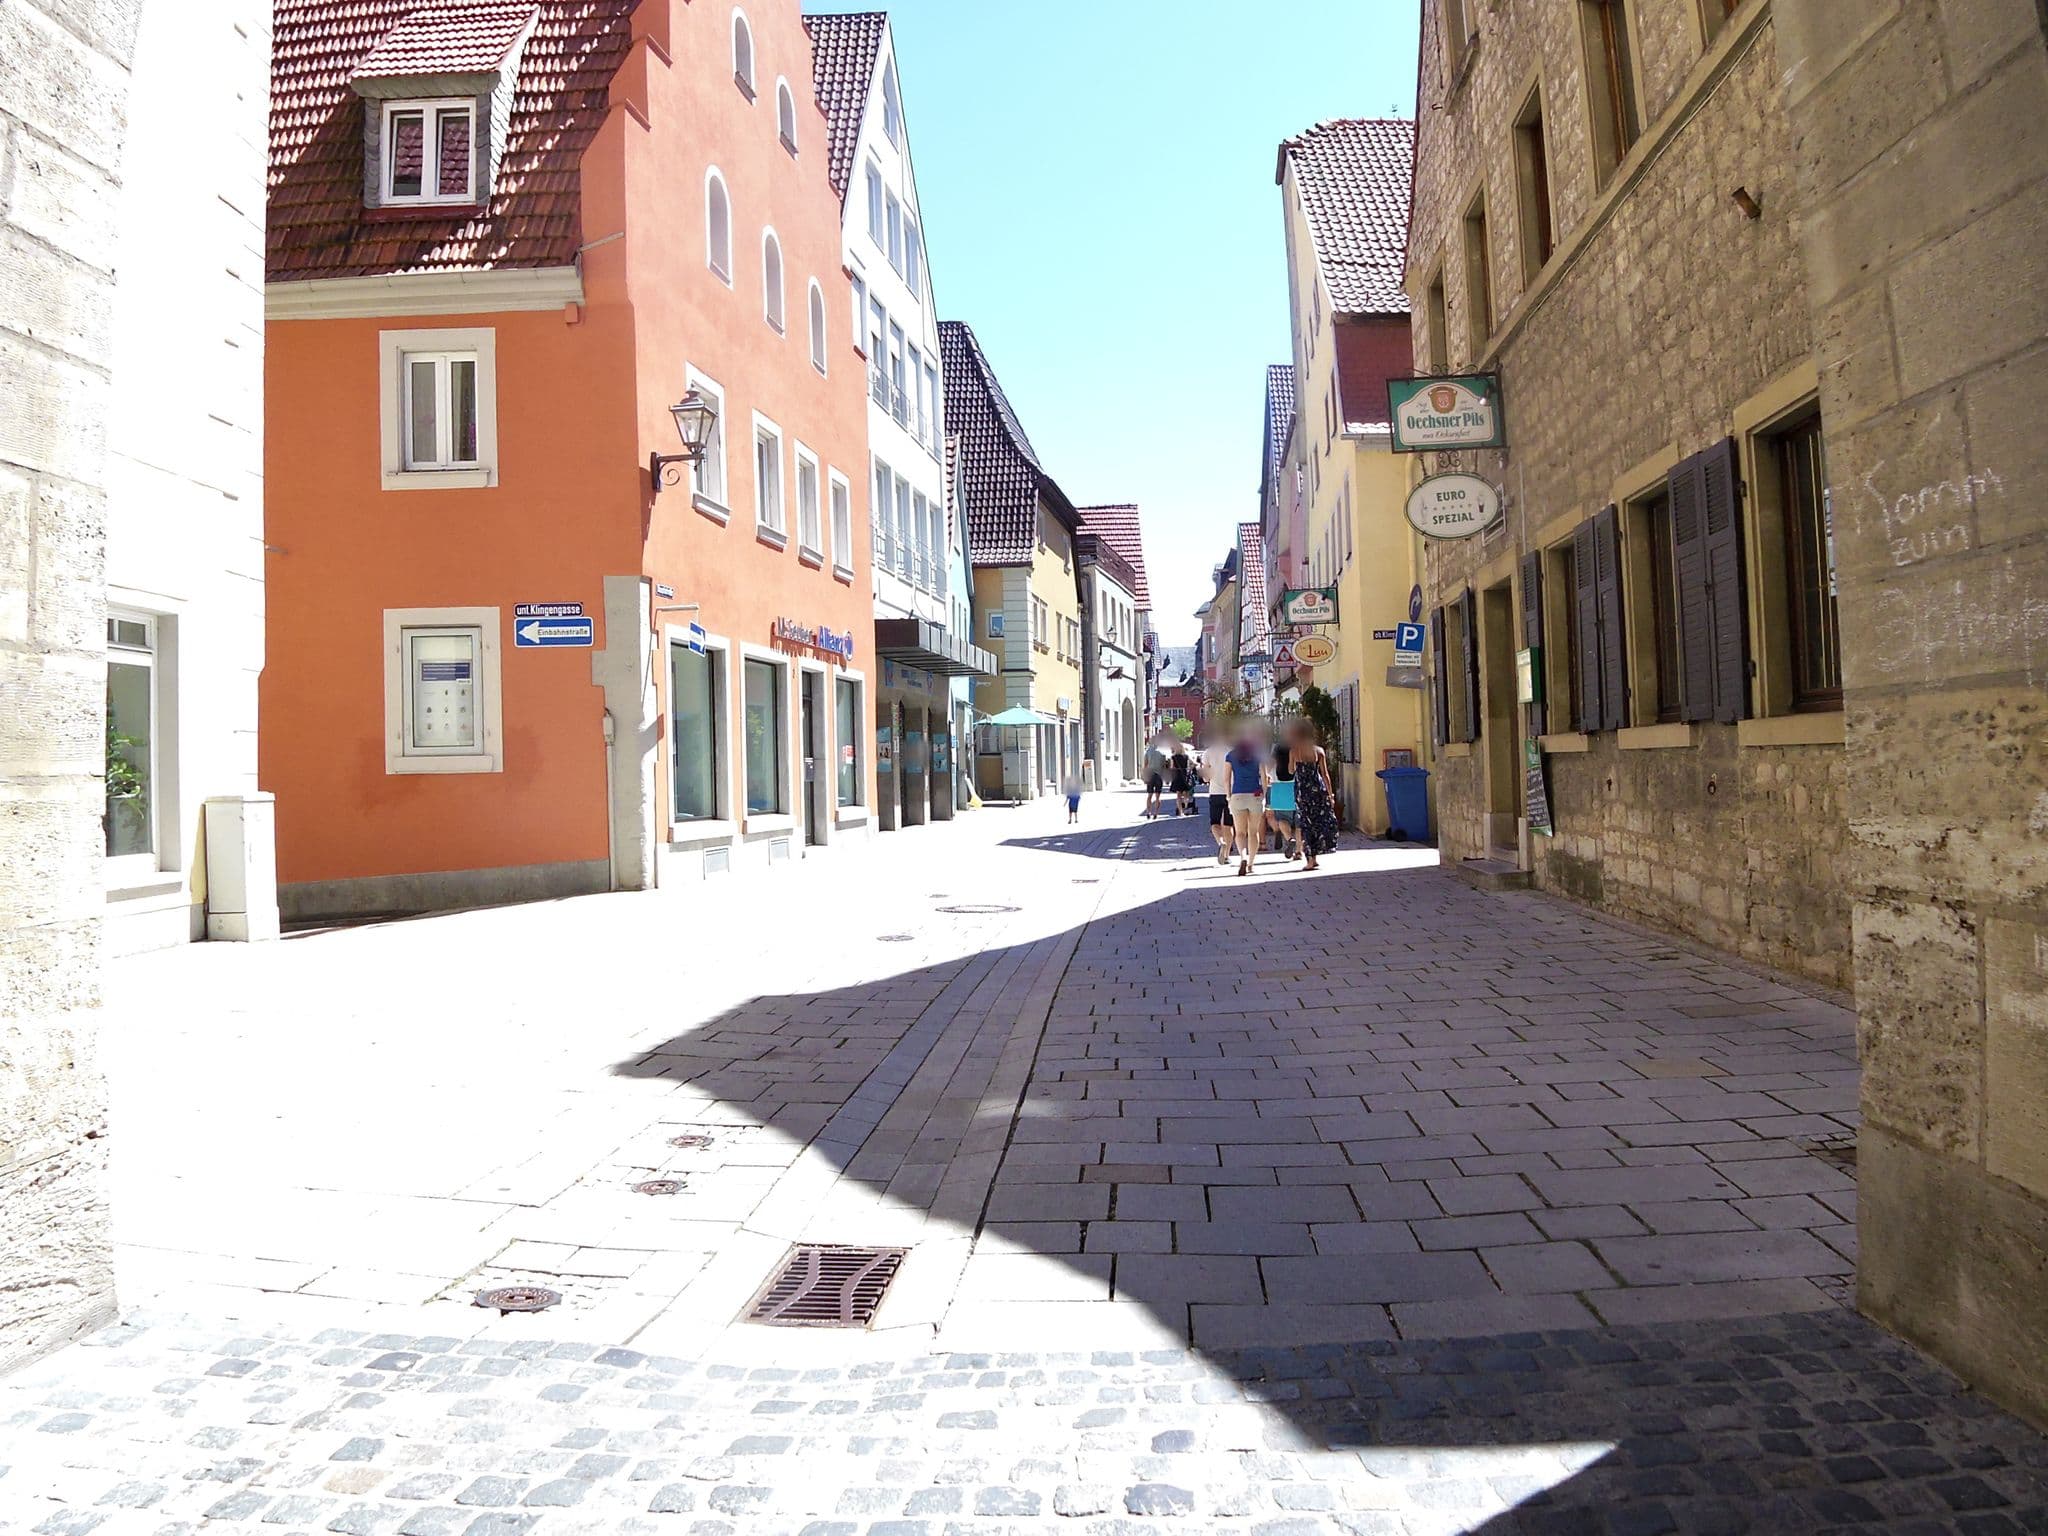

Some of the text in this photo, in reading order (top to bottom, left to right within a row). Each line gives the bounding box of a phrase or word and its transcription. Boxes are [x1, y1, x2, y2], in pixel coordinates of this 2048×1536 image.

[1463, 412, 1484, 427] Pils
[1436, 490, 1466, 502] EURO
[1432, 512, 1475, 525] SPEZIAL
[537, 628, 588, 636] Einbahnstraße
[818, 625, 844, 653] Allianz
[1402, 626, 1419, 647] P
